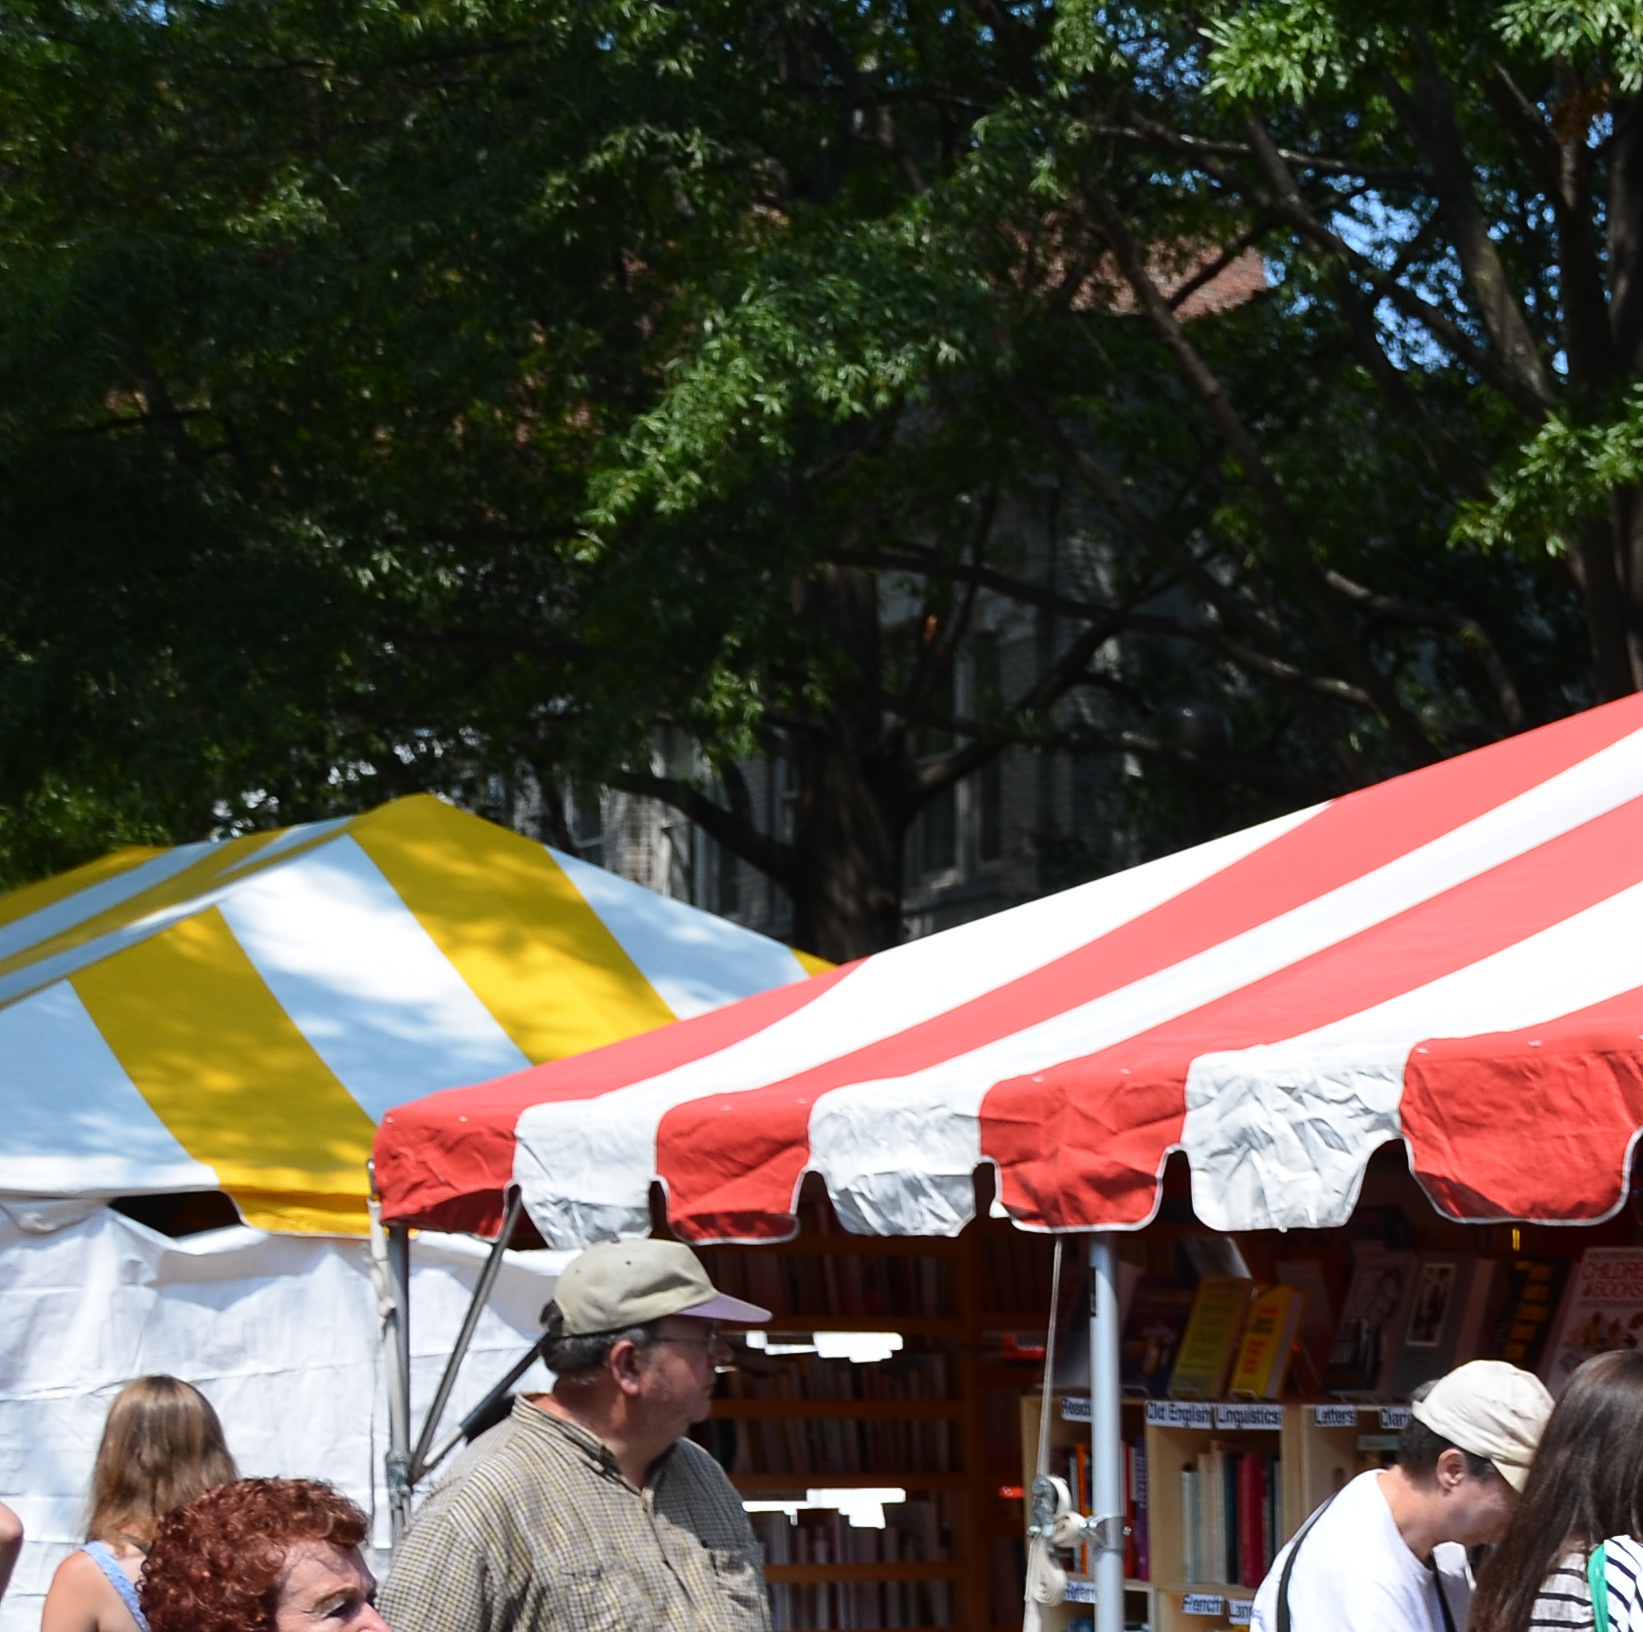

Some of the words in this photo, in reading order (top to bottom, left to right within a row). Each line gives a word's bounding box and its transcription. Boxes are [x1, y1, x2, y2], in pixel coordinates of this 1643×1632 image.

[1169, 1403, 1212, 1427] English
[1215, 1405, 1281, 1429] Linguistics
[1314, 1407, 1356, 1426] Letters
[1182, 1594, 1223, 1615] French
